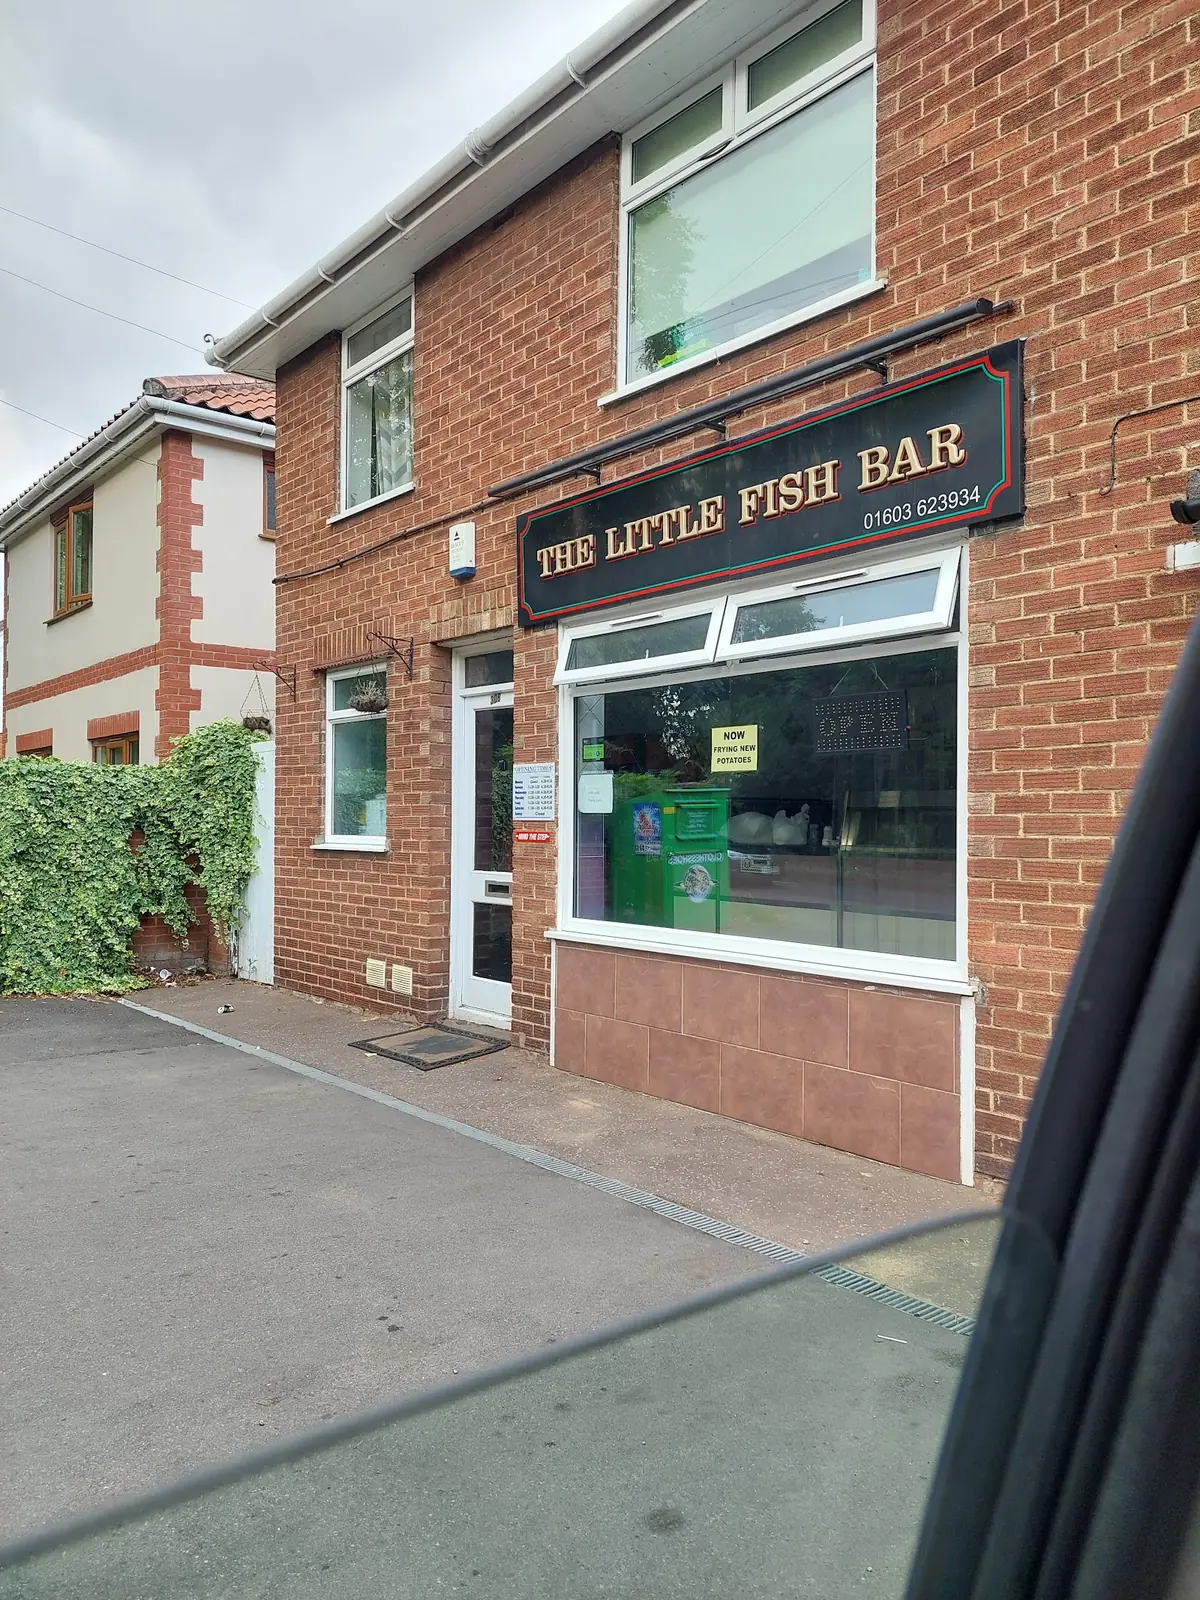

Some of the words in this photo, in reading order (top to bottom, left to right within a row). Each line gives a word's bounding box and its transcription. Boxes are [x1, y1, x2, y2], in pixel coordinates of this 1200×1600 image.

[536, 534, 595, 580] THE
[604, 495, 724, 561] LITTLE
[737, 459, 840, 526] FISH
[857, 423, 966, 492] BAR
[863, 503, 912, 529] 01603
[917, 485, 980, 516] 623934
[820, 711, 899, 736] OPEN
[723, 731, 745, 740] NOW
[713, 745, 738, 753] FRYING
[740, 744, 756, 752] NEW
[716, 756, 752, 764] POTATOES
